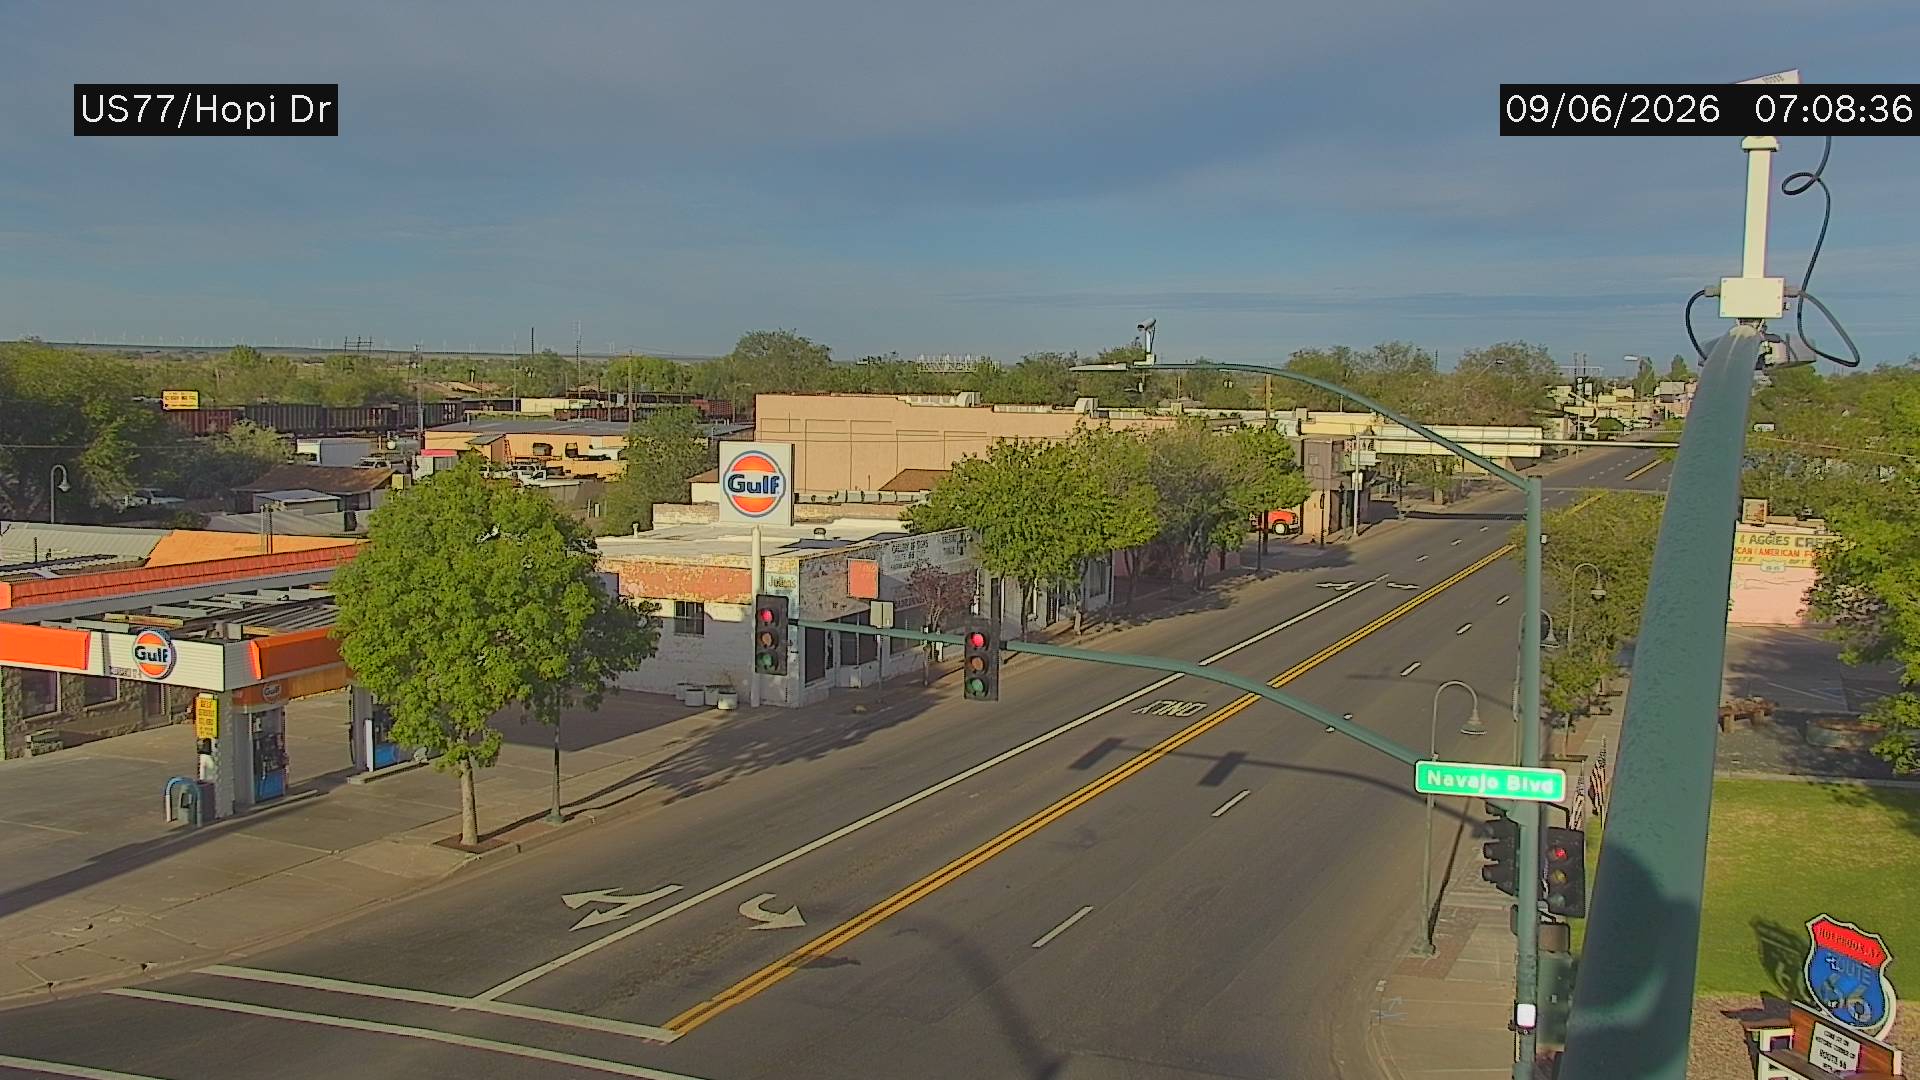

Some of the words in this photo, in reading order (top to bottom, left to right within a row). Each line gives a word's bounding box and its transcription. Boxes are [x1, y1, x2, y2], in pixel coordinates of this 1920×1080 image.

[728, 473, 780, 494] Gulf
[134, 645, 169, 663] Gulf
[1427, 769, 1498, 795] Navajo
[1507, 774, 1554, 794] Blvd
